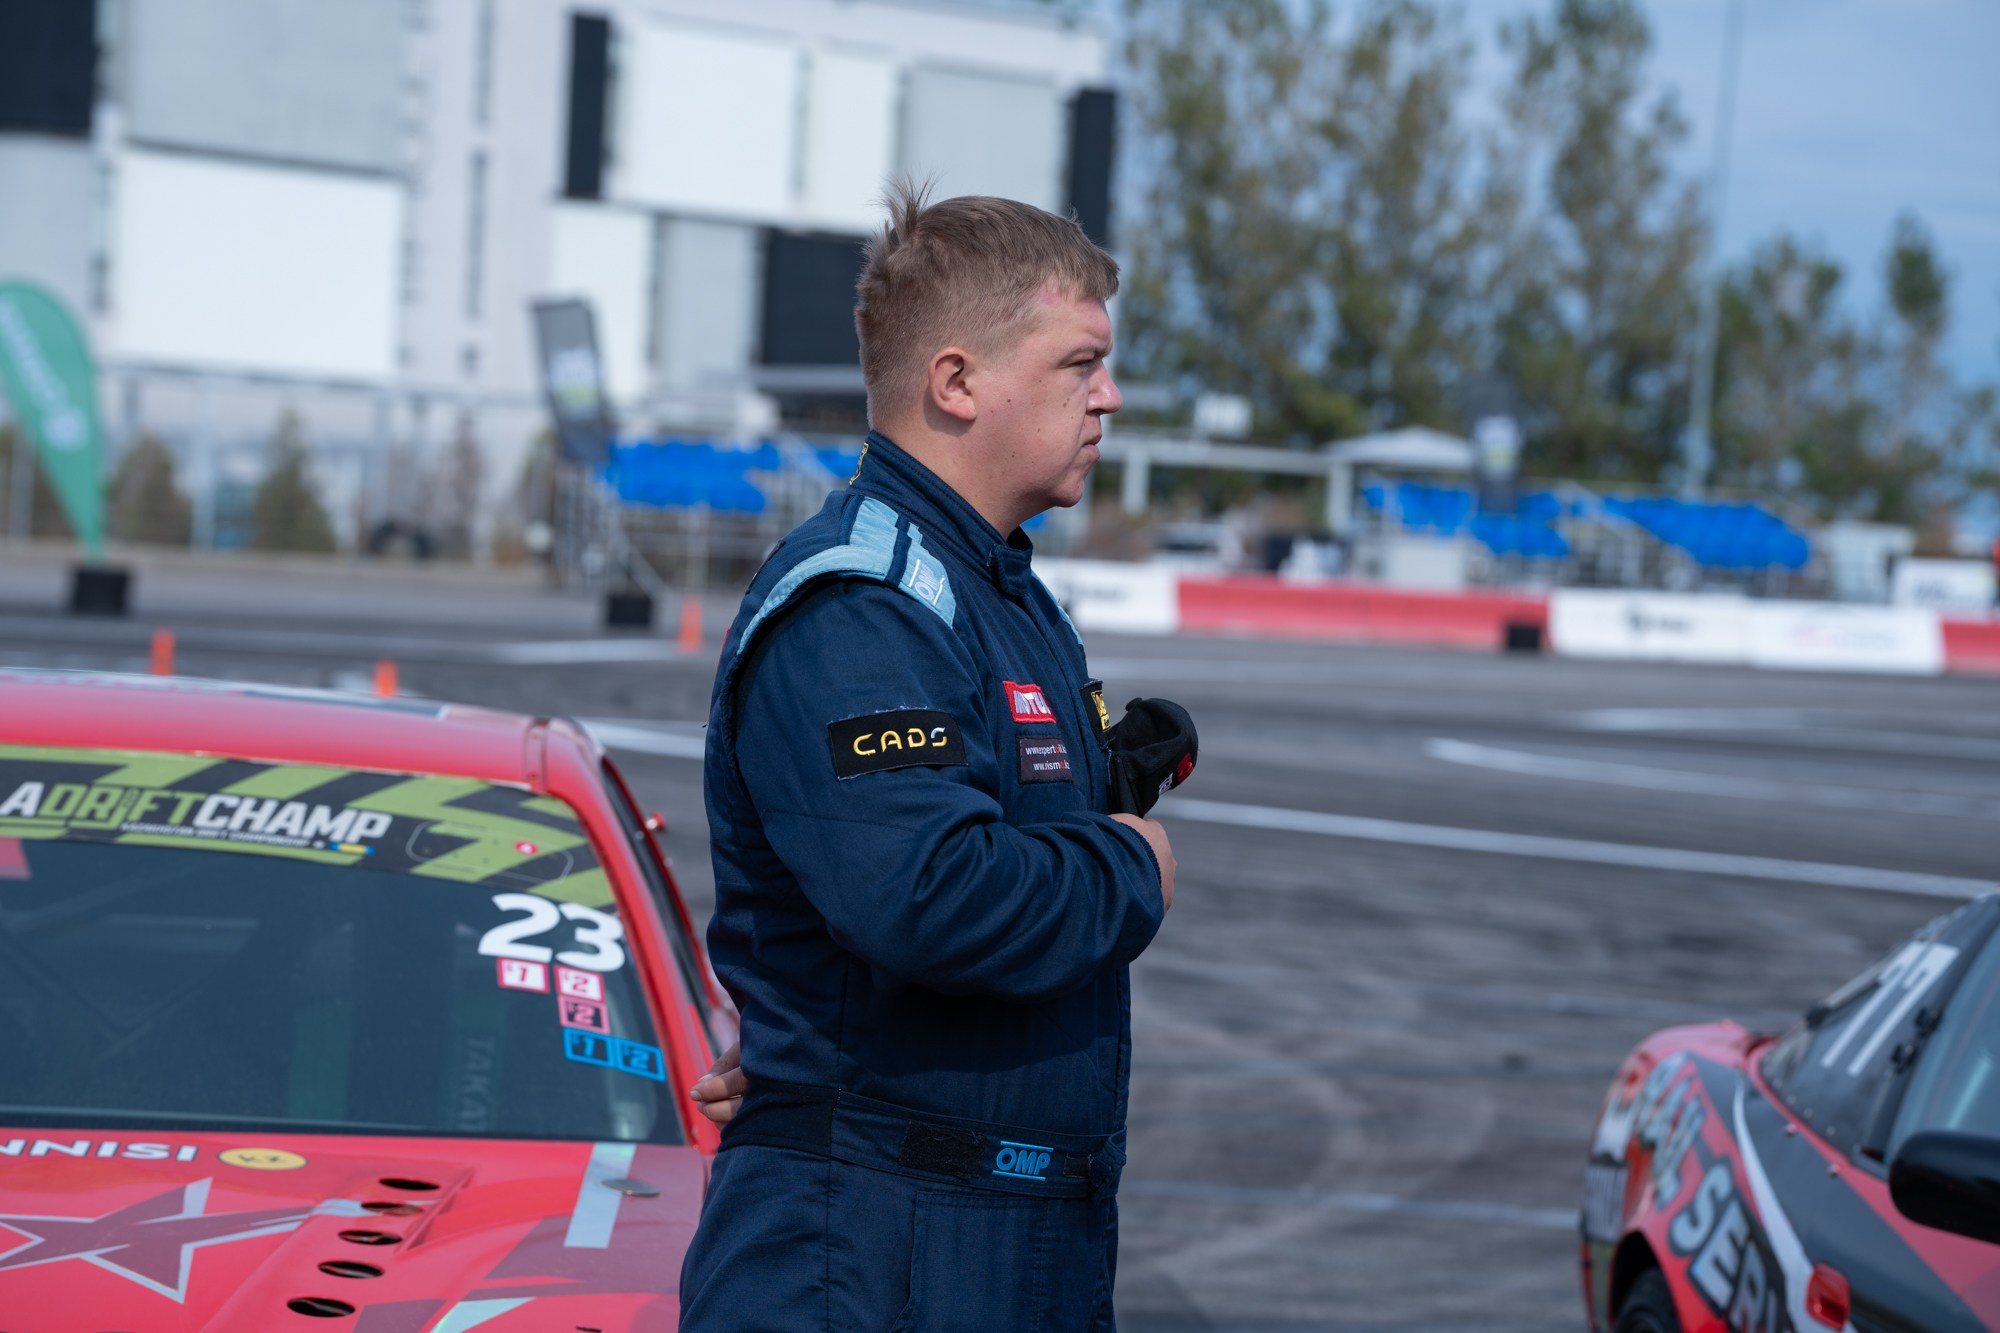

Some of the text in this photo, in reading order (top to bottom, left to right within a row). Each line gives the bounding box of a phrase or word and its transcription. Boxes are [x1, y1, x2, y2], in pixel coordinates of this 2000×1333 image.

[853, 727, 948, 756] CADS
[478, 893, 625, 972] 23
[996, 1147, 1050, 1175] OMP
